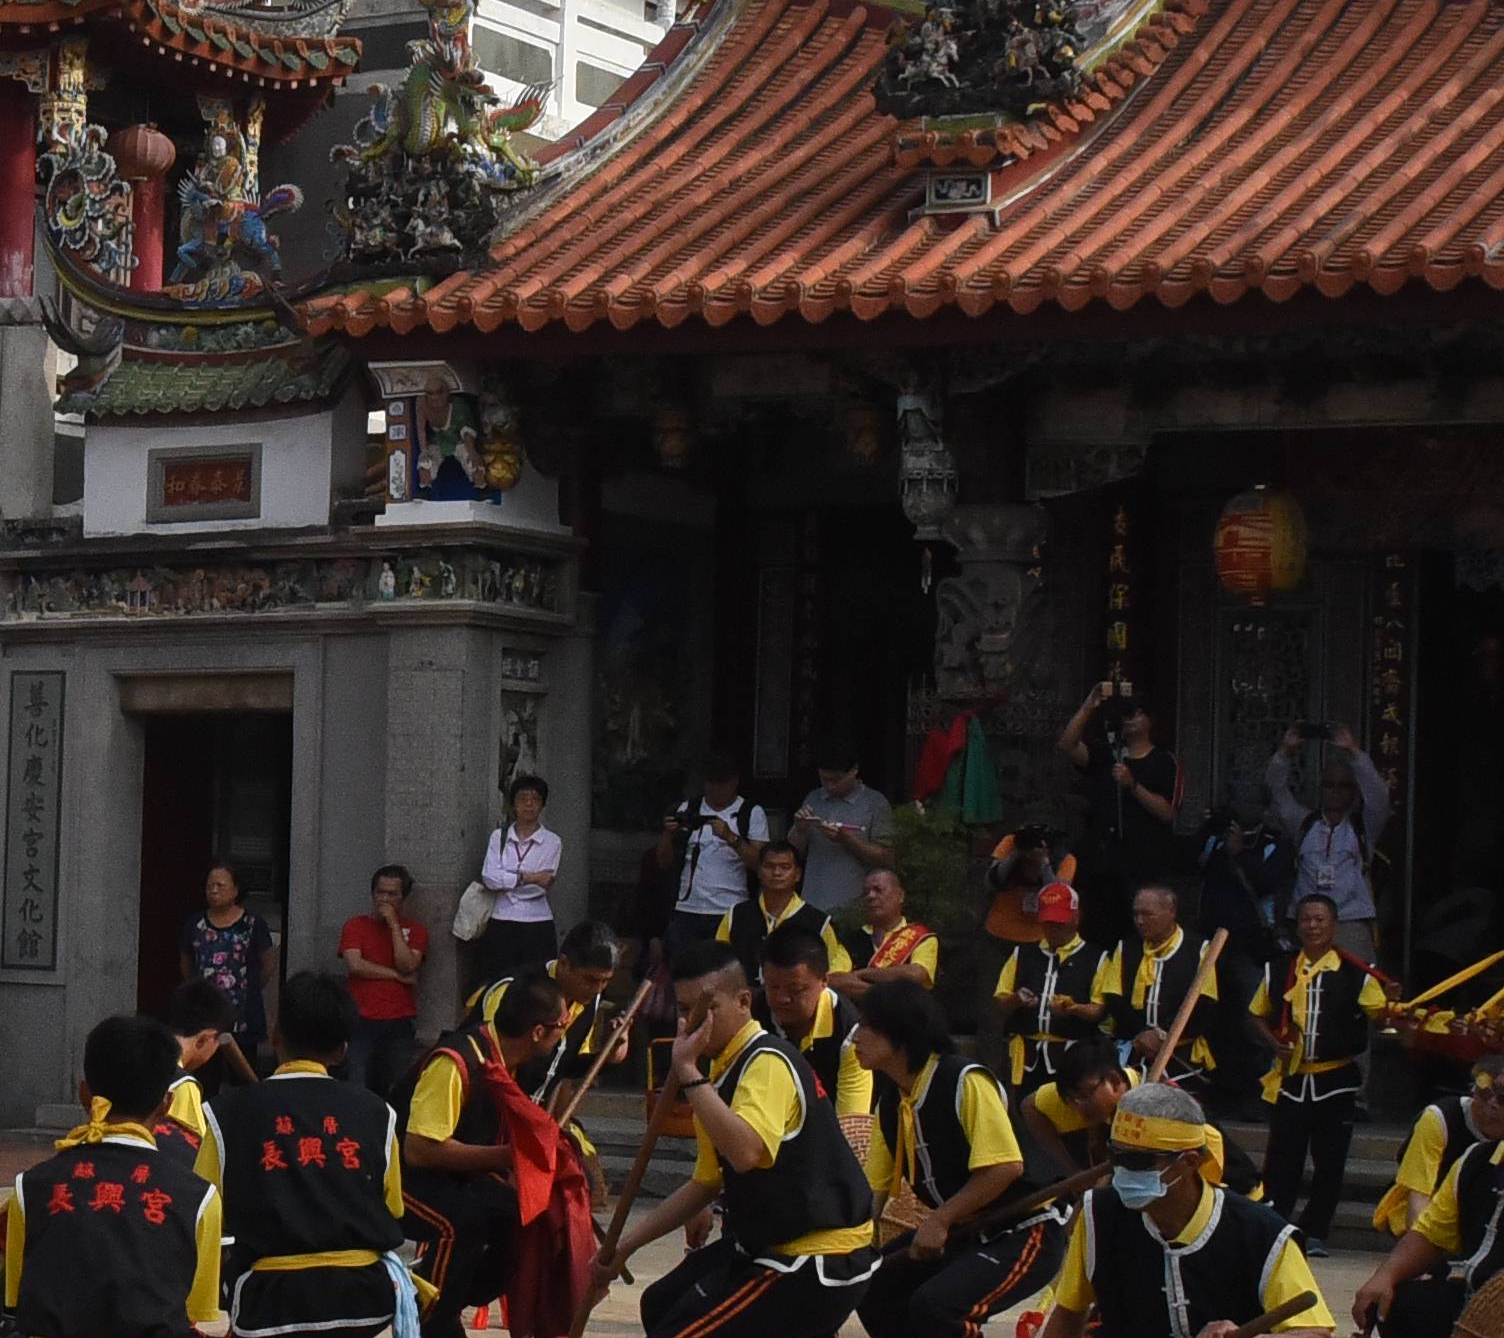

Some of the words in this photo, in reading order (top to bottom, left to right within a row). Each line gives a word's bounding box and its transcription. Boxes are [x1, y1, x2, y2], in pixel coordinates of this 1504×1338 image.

[16, 680, 50, 960] 善化慶安宮文化館
[260, 1137, 360, 1171] 長興宮
[49, 1182, 173, 1225] 長興宮
